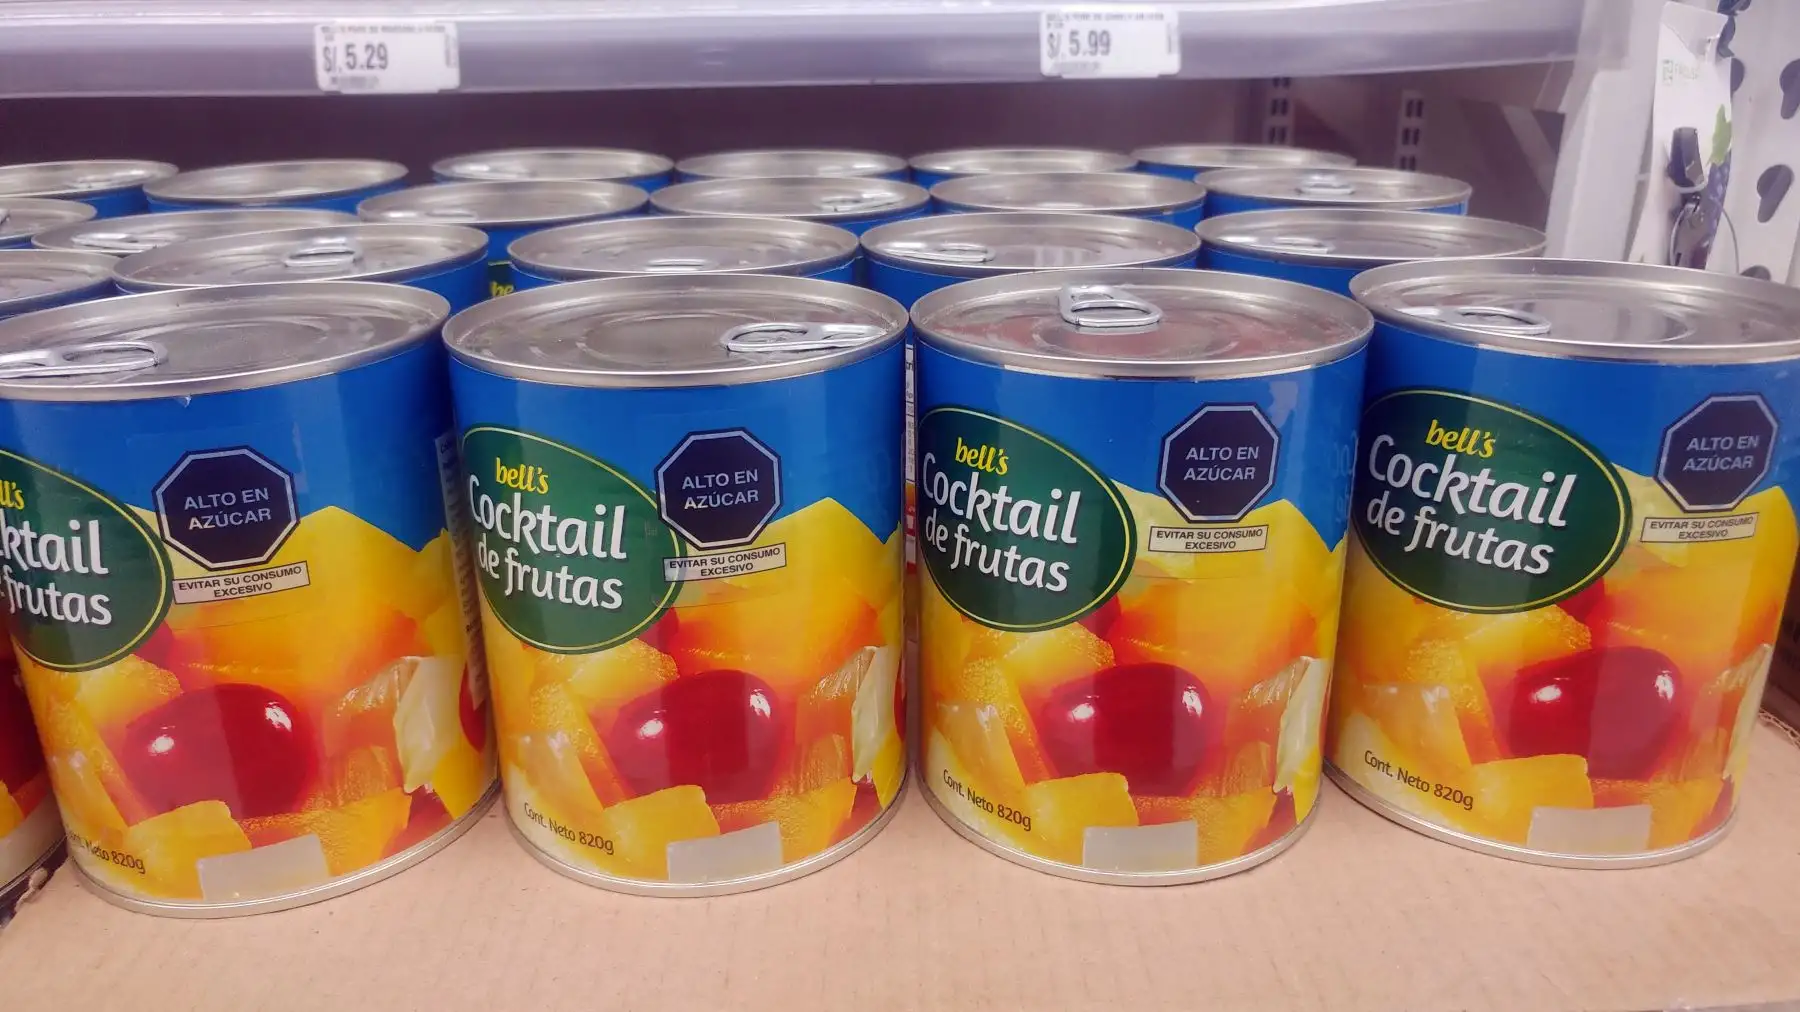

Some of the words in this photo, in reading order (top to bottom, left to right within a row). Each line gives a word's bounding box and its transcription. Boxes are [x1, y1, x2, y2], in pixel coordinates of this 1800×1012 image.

[1068, 30, 1111, 56] 5.99
[345, 43, 389, 71] 5.29
[1425, 418, 1496, 459] bell's
[1686, 436, 1733, 451] ALTO
[1737, 435, 1760, 450] EN
[954, 436, 1009, 476] bell's
[1185, 446, 1232, 461] ALTO
[1236, 446, 1259, 461] EN
[1682, 454, 1754, 472] AZÚCAR
[495, 456, 549, 495] bell's
[682, 472, 729, 490] ALTO
[734, 468, 759, 484] EN
[1183, 464, 1256, 482] AZÚCAR
[1369, 434, 1577, 527] Cocktail
[0, 479, 25, 510] ll's
[184, 491, 237, 511] ALTO
[241, 487, 269, 504] EN
[683, 489, 759, 510] AZÚCAR
[922, 452, 1081, 544] Cocktail
[188, 507, 272, 531] AZÚCAR
[469, 474, 627, 560] Cocktail
[1650, 520, 1689, 530] EVITAR
[1691, 520, 1706, 530] SU
[1706, 516, 1754, 529] CONSUMO
[0, 507, 109, 575] ktail
[1156, 530, 1195, 540] EVITAR
[1196, 530, 1213, 540] SU
[1213, 528, 1263, 540] CONSUMO
[1185, 540, 1237, 550] EXCESIVO
[1366, 490, 1405, 536] de
[1404, 505, 1554, 575] frutas
[1678, 529, 1729, 540] EXCESIVO
[669, 558, 708, 569] EVITAR
[710, 556, 726, 566] SU
[728, 547, 781, 563] CONSUMO
[925, 508, 949, 553] de
[950, 523, 1070, 592] frutas
[178, 578, 221, 592] EVITAR
[223, 575, 240, 586] SU
[242, 565, 303, 584] CONSUMO
[477, 532, 501, 580] de
[504, 546, 624, 610] frutas
[700, 562, 754, 577] EXCESIVO
[3, 564, 112, 625] frutas
[213, 581, 273, 599] EXCESIVO
[1364, 750, 1393, 777] Cont.
[1397, 767, 1430, 793] Neto
[1433, 783, 1474, 811] 820g
[943, 768, 965, 798] Cont.
[967, 786, 994, 814] Neto
[997, 803, 1032, 832] 820g
[548, 817, 576, 842] Neto
[578, 830, 615, 856] 820g
[110, 850, 146, 875] 820g
